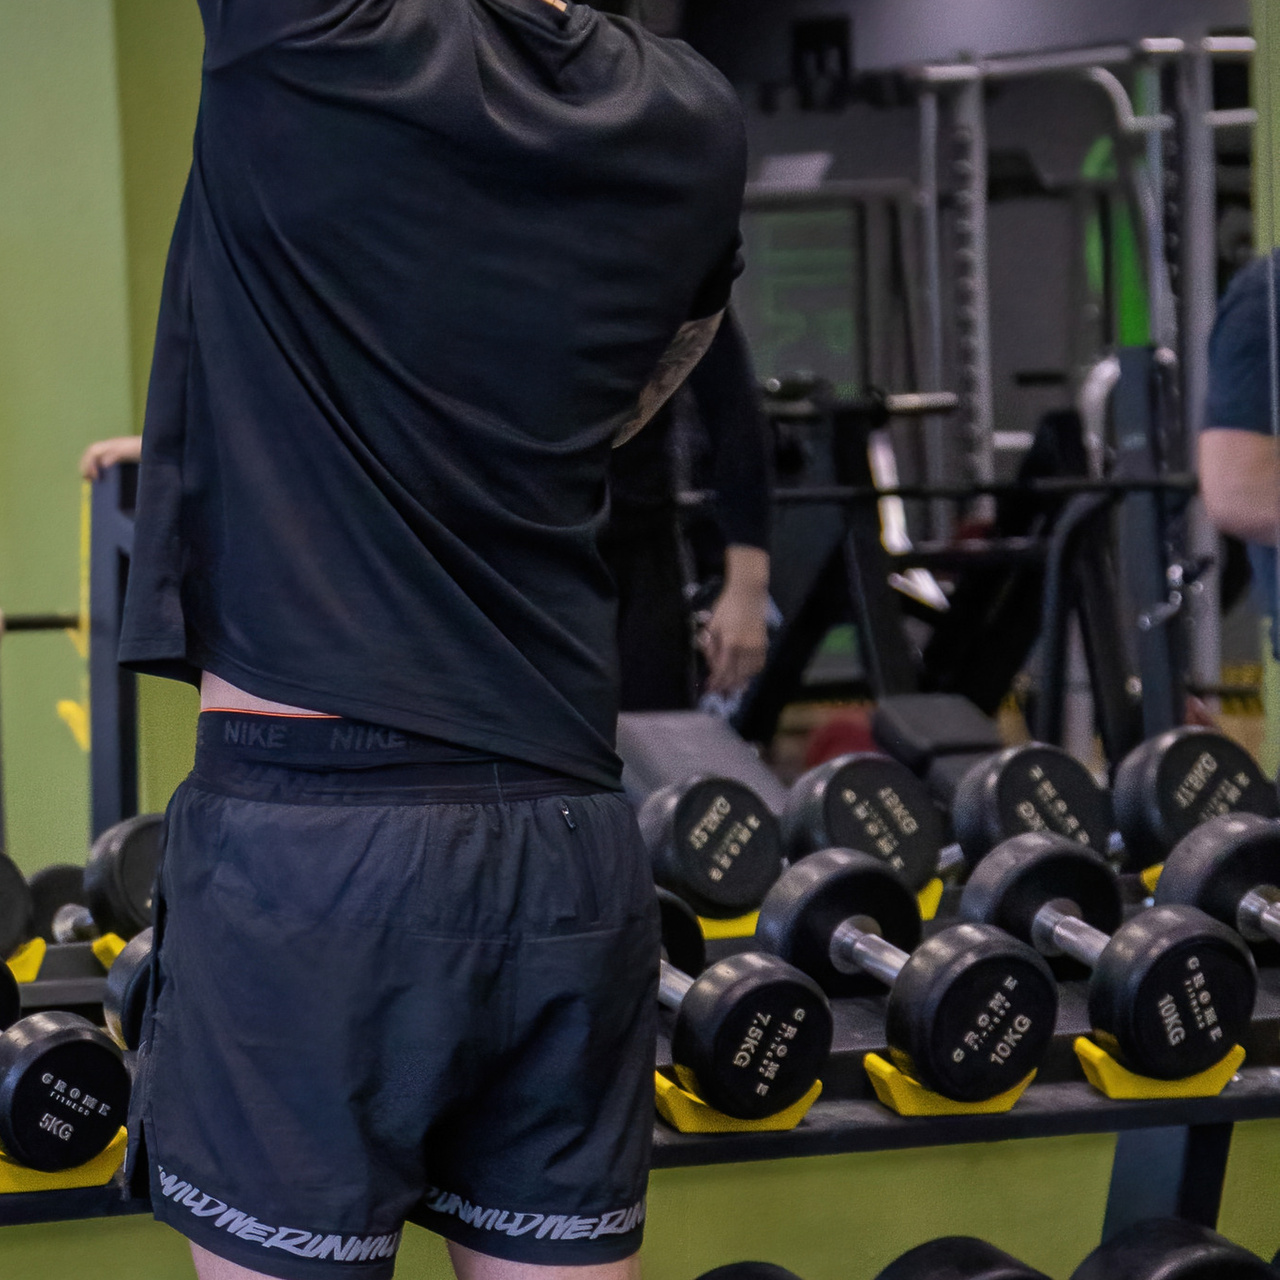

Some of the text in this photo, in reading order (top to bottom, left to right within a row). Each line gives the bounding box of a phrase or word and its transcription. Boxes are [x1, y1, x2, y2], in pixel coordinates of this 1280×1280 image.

[224, 719, 409, 752] NIKE NIKE
[952, 975, 1019, 1063] GROME
[1158, 993, 1186, 1047] 10KG
[1188, 956, 1223, 1042] GROME
[733, 1012, 772, 1068] 7.5KG
[756, 1008, 806, 1097] GROME
[990, 1014, 1032, 1065] 10KG
[41, 1072, 112, 1117] GROME
[49, 1091, 90, 1116] FITNESS
[39, 1112, 74, 1141] 5KG
